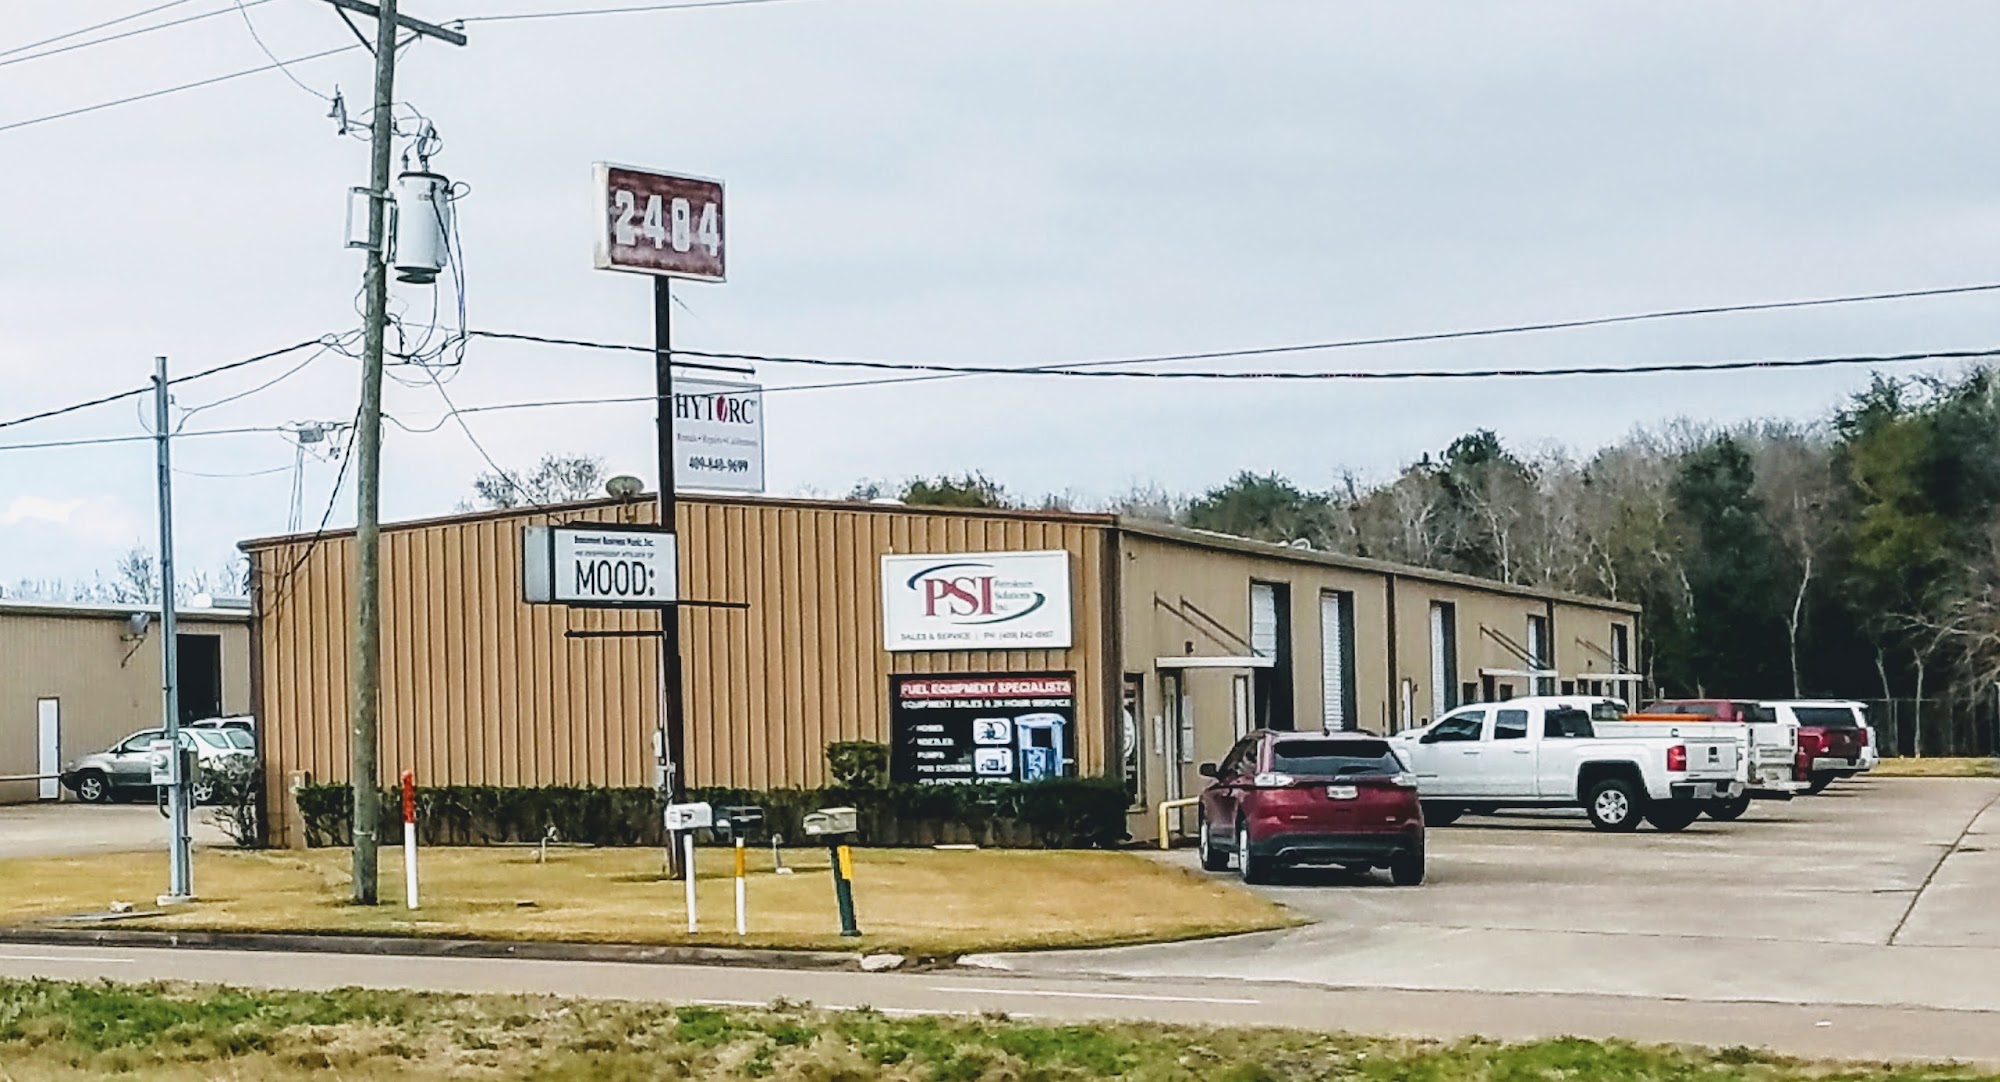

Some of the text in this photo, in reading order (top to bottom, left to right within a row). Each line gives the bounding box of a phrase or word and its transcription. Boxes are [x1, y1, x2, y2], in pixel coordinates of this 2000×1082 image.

[575, 560, 655, 595] MOOD:
[924, 577, 997, 617] PSI
[901, 681, 1072, 695] FUEL EQUIPMENT SPECIALISTS
